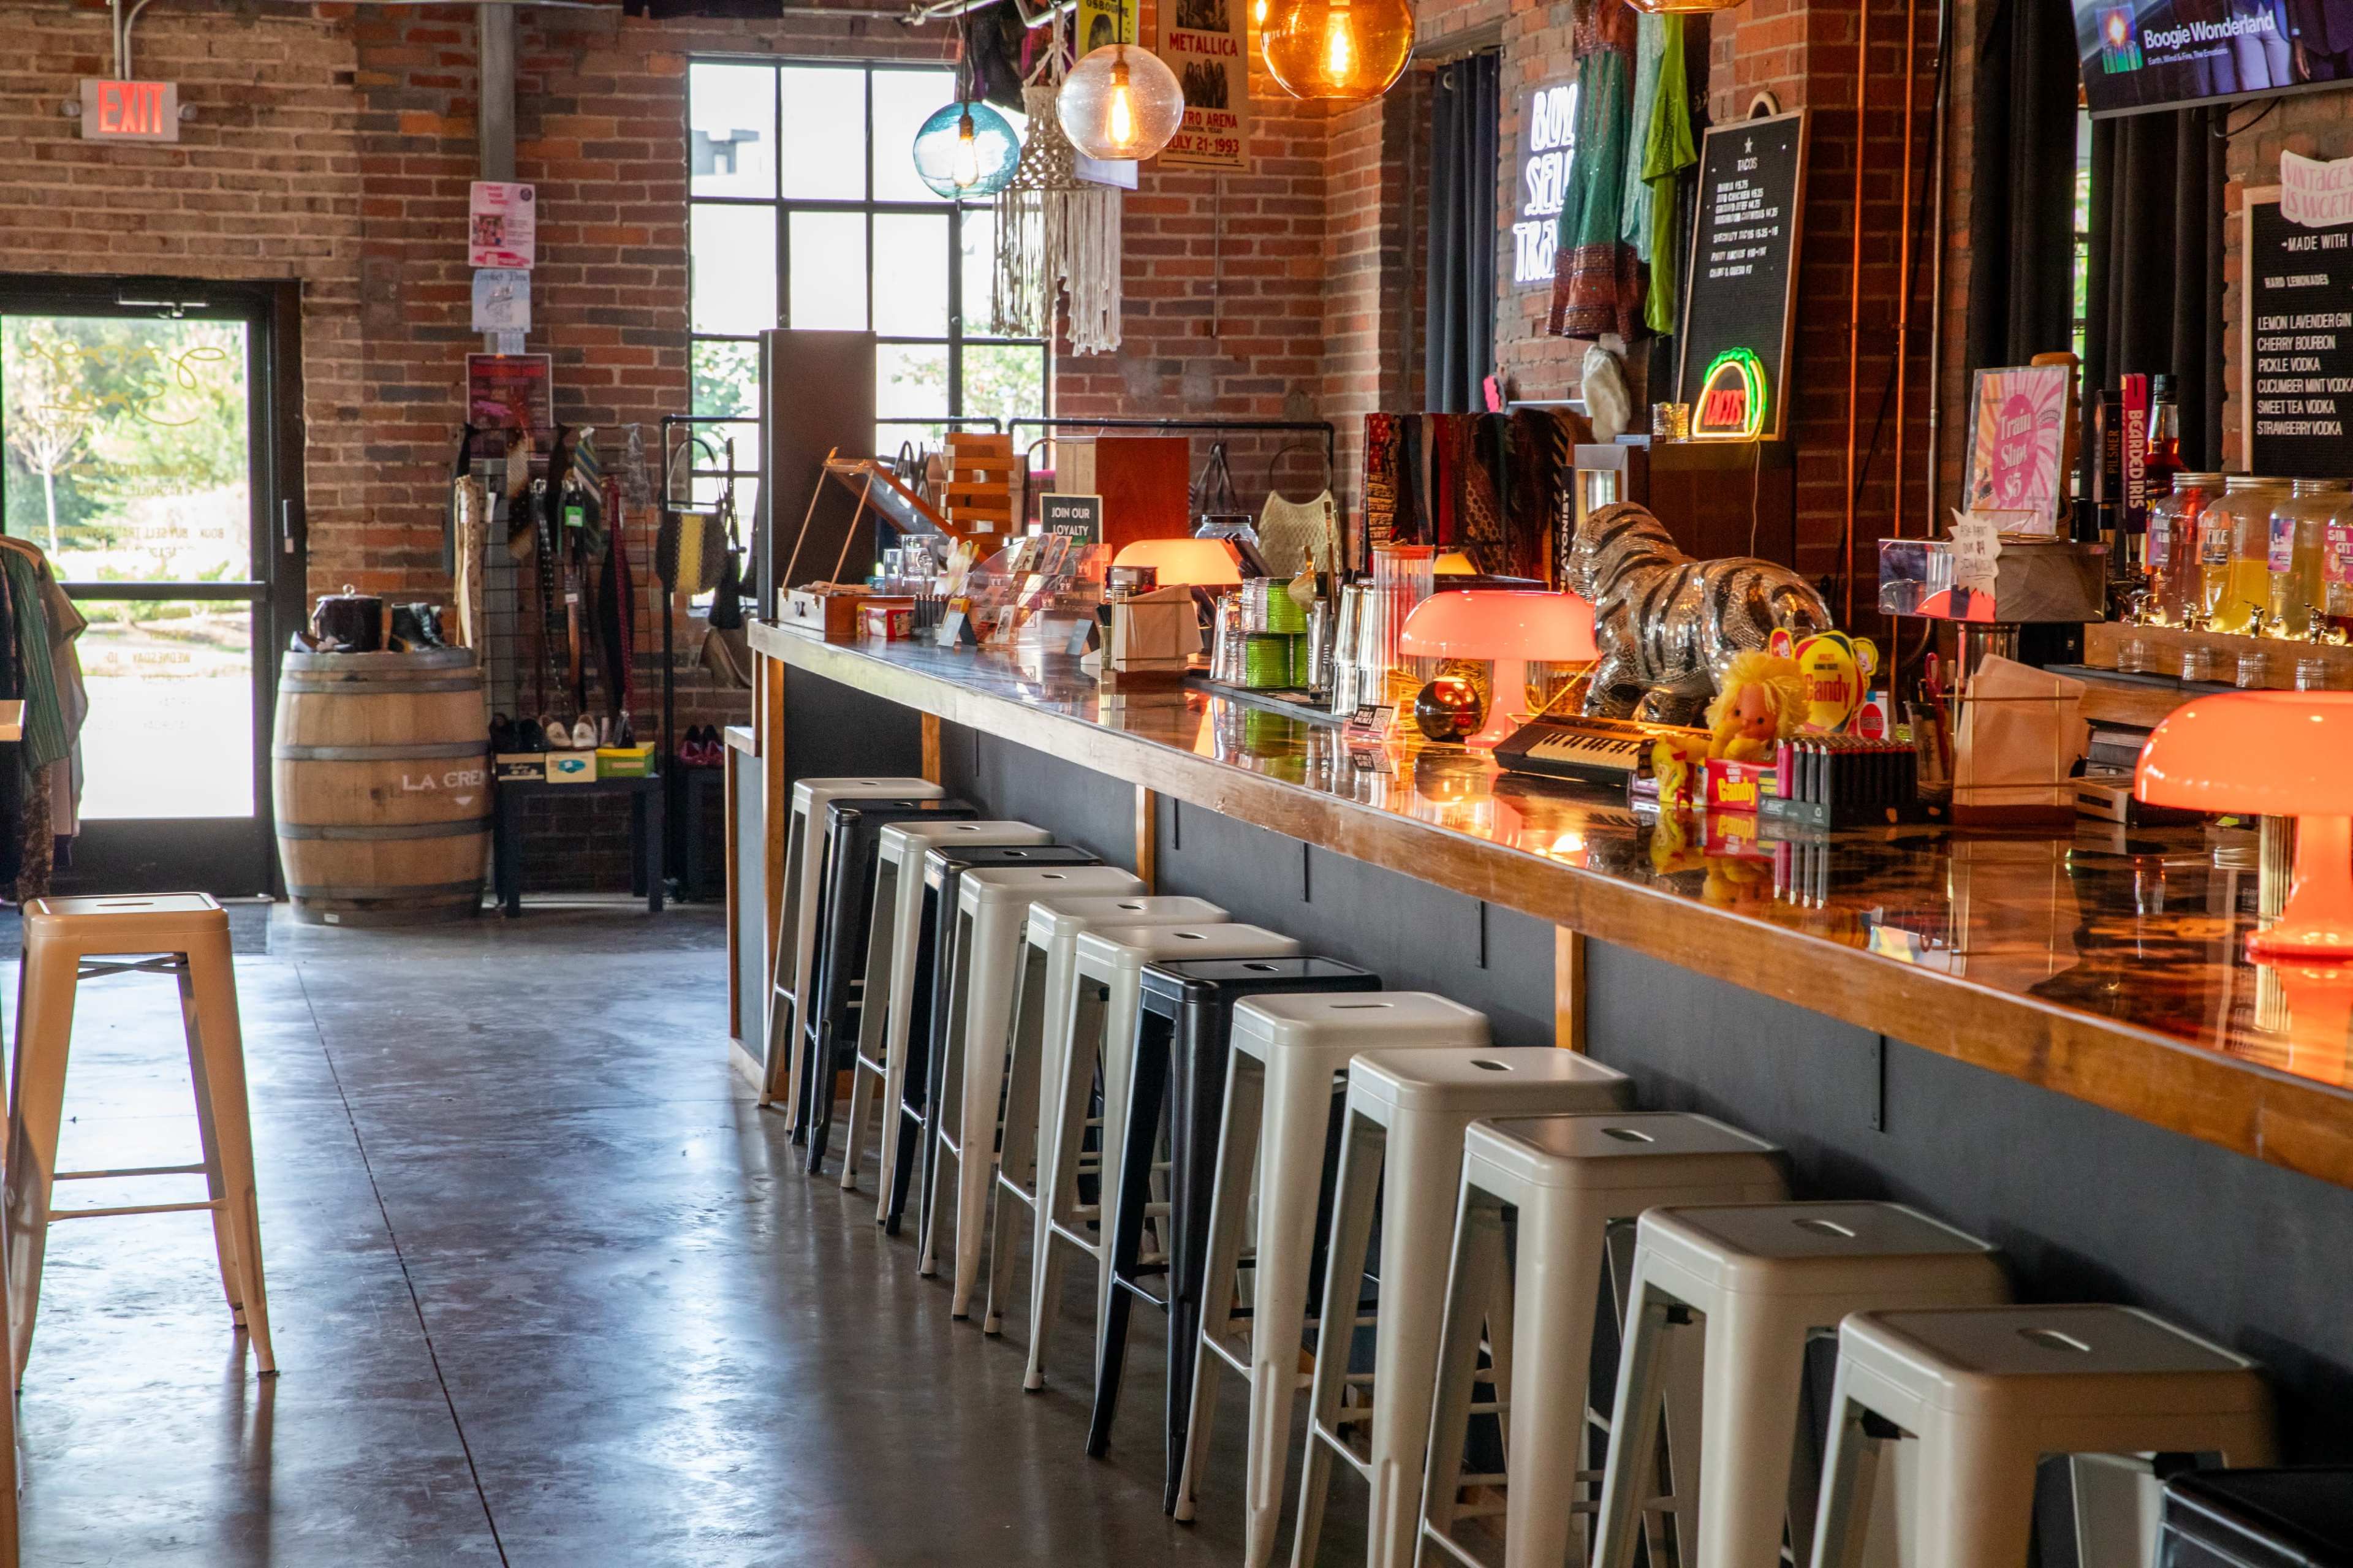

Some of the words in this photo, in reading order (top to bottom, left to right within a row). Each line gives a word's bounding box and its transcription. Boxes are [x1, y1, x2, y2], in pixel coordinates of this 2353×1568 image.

[2143, 25, 2191, 50] Boogie
[2189, 10, 2276, 42] Wonderland
[1169, 32, 1238, 56] METALLICA
[98, 81, 166, 134] EXIT
[1531, 83, 1577, 151] BUY
[1183, 111, 1202, 125] TRO
[1206, 113, 1238, 129] ARENA
[1737, 157, 1758, 172] TACOS
[2284, 187, 2298, 214] IS
[1512, 219, 1558, 282] TRA
[2287, 235, 2318, 252] MADE
[2321, 233, 2348, 249] WITH
[2287, 274, 2330, 287] LEMONADES
[2257, 316, 2288, 331] LEMON
[2290, 313, 2335, 329] LAVENDER
[2336, 312, 2352, 327] GIN
[2257, 337, 2294, 351] CHERRY
[2295, 335, 2336, 350] BOURBON
[2258, 358, 2289, 373] PICKLE
[2290, 357, 2321, 371] VODKA
[2257, 378, 2304, 393] CUCUMBER
[2305, 378, 2327, 393] MINT
[2327, 377, 2353, 392] VODKA
[1703, 389, 1746, 426] TACOS
[2257, 400, 2286, 414] SWEET
[2287, 400, 2305, 414] TEA
[2305, 400, 2336, 414] VODKA
[1999, 407, 2032, 441] Train
[2257, 420, 2311, 435] STRAWBERRY
[2311, 420, 2343, 436] VODKA
[2107, 430, 2120, 474] PILSNER
[2128, 410, 2145, 479] BEARDED
[2000, 442, 2028, 471] Shot
[2001, 472, 2022, 501] $5
[2129, 480, 2145, 509] IRIS
[1051, 507, 1070, 518] JOIN
[1072, 507, 1090, 519] OUR
[1053, 525, 1089, 536] LOYALTY
[2327, 529, 2346, 542] SIN
[2335, 542, 2353, 554] CIT
[1804, 673, 1851, 710] Candy
[402, 775, 436, 791] LA
[1717, 776, 1756, 806] Candy
